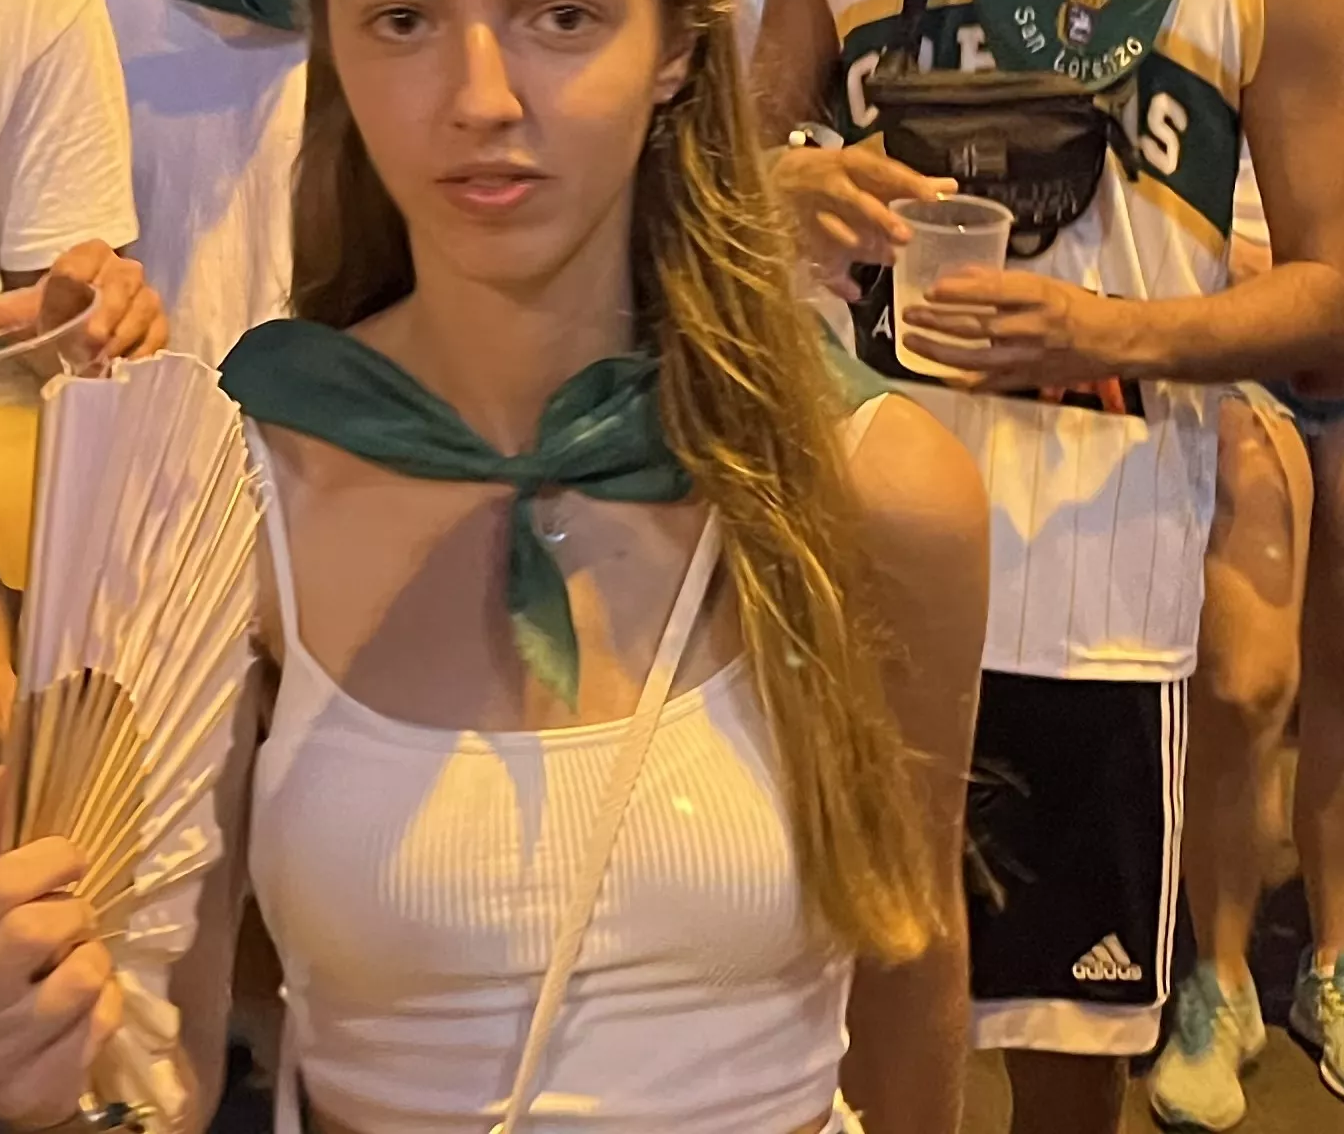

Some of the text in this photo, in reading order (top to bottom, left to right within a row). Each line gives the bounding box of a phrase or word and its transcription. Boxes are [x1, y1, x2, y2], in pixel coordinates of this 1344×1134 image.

[1014, 5, 1143, 80] San Lorenzo
[1072, 960, 1142, 981] adidas
